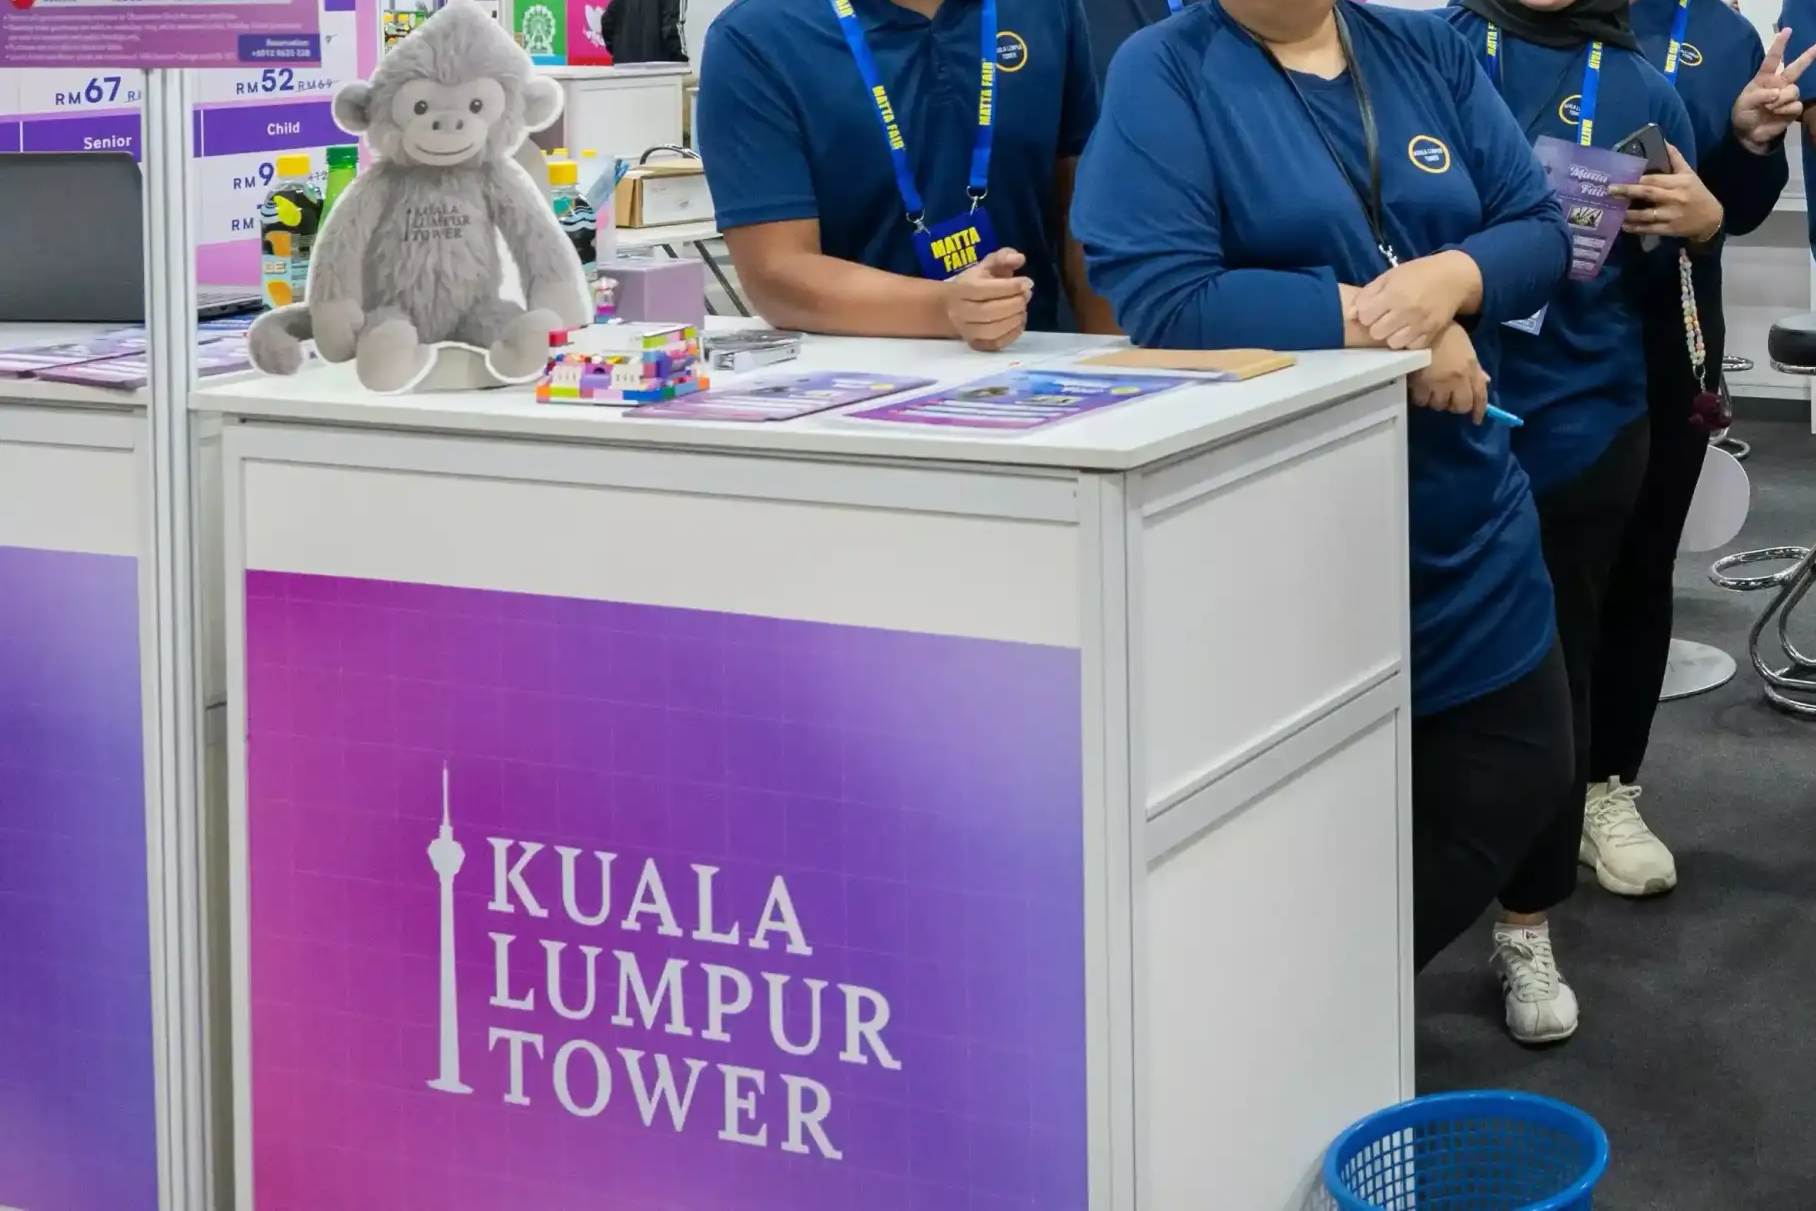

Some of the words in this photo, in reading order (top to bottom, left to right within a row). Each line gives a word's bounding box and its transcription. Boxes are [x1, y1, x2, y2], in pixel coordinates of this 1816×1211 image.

[236, 82, 258, 94] RM
[261, 68, 295, 92] 52
[981, 61, 997, 88] FAIR
[55, 92, 82, 106] RM
[84, 77, 122, 103] 67
[872, 85, 896, 123] MATTA
[979, 88, 994, 125] MATTA
[83, 135, 132, 150] Senior
[267, 122, 301, 135] Child
[883, 120, 905, 150] FAIR
[234, 177, 256, 189] RM
[231, 219, 254, 231] RM
[930, 226, 981, 260] MATTA
[944, 246, 978, 273] FAIR
[487, 836, 812, 956] KUALA
[488, 931, 901, 1070] LUMPUR
[488, 1025, 842, 1159] TOWER
